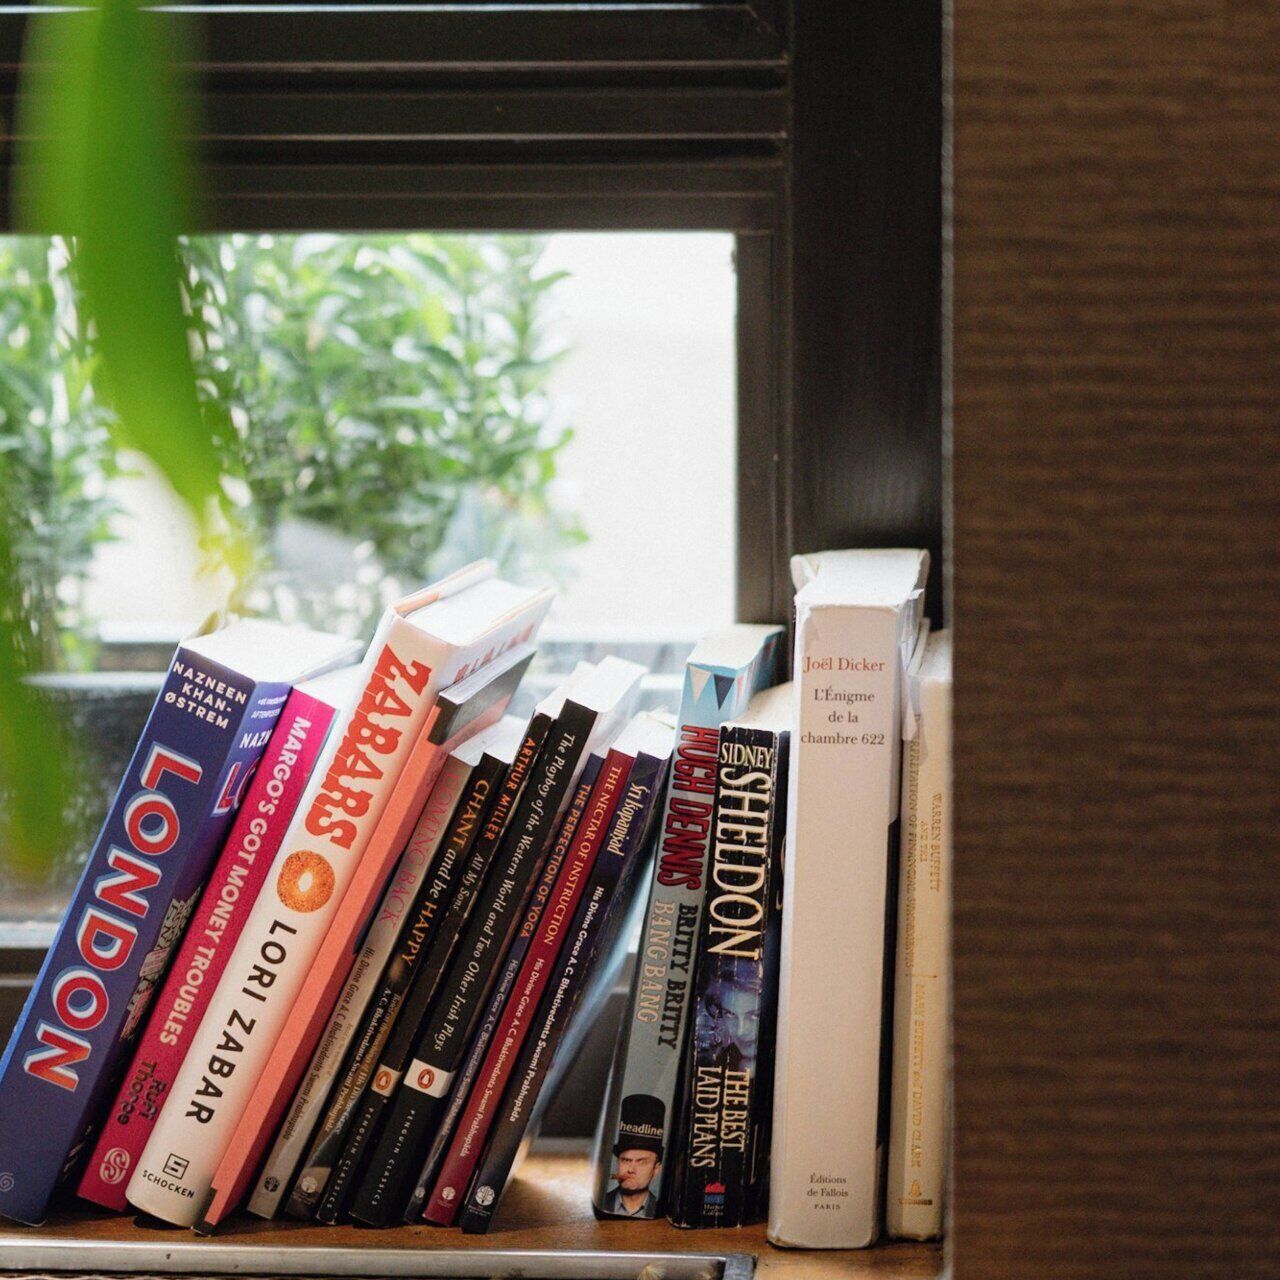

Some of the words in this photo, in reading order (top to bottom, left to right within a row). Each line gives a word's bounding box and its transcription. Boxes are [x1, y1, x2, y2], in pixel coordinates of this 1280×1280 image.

[803, 656, 832, 674] Joël
[838, 657, 885, 672] Dicker
[173, 661, 247, 705] NAZNEEN
[182, 682, 232, 712] KHAN-
[814, 685, 875, 706] L'Énigme
[164, 691, 230, 730] ØSTREM
[828, 710, 844, 722] de
[848, 712, 858, 723] la
[304, 643, 432, 850] ZABARS
[558, 733, 575, 753] The
[800, 731, 858, 744] chambre
[861, 733, 885, 746] 622
[258, 716, 312, 816] MARGO'S
[507, 738, 535, 789] ARTHUR
[672, 724, 720, 795] HUGH
[720, 742, 774, 770] SIDNEY
[538, 755, 565, 797] Playboy
[604, 767, 622, 791] THE
[531, 799, 544, 816] of
[575, 785, 591, 807] THE
[453, 780, 489, 847] CHANT
[485, 794, 510, 839] MILLER
[526, 813, 539, 831] the
[584, 792, 610, 839] NECTAR
[908, 814, 917, 828] OF
[931, 793, 941, 841] WARREN
[238, 817, 268, 865] GOT
[507, 835, 533, 874] Western
[544, 809, 579, 883] PERFECTION
[578, 842, 591, 859] OF
[657, 798, 714, 890] DENNIS
[438, 849, 456, 878] and
[471, 853, 483, 870] All
[707, 767, 771, 961] SHELDON
[906, 832, 916, 894] FINANCIAL
[930, 844, 940, 892] BUFFETT
[429, 879, 446, 898] be
[463, 870, 476, 886] My
[537, 885, 548, 902] OF
[592, 886, 604, 900] His
[202, 864, 249, 944] MONEY
[379, 867, 418, 927] BACK
[453, 887, 469, 910] Sons
[493, 879, 514, 912] World
[544, 861, 583, 944] INSTRUCTION
[23, 740, 203, 1092] LONDON
[483, 912, 496, 935] and
[520, 906, 541, 937] YOGA
[582, 901, 598, 929] Divine
[646, 899, 676, 961] BANG
[399, 902, 437, 965] HAPPY
[473, 937, 490, 957] Two
[572, 930, 587, 956] Grace
[670, 903, 698, 974] BRITTY
[242, 920, 298, 1003] LORI
[362, 946, 375, 959] His
[508, 959, 518, 971] His
[533, 958, 544, 971] His
[352, 959, 369, 983] Divine
[460, 961, 479, 993] Other
[499, 971, 513, 992] Divine
[524, 971, 539, 995] Divine
[160, 944, 216, 1047] TROUBLES
[342, 983, 358, 1004] Grace
[447, 995, 465, 1020] Irish
[491, 993, 504, 1012] Grace
[515, 996, 529, 1017] Grace
[637, 963, 666, 1022] BANG
[541, 978, 569, 1039] Bhaktivedanta
[658, 978, 687, 1050] BRITTY
[434, 1023, 453, 1051] Plays
[184, 1008, 256, 1125] ZABAR
[487, 1037, 513, 1088] Bhaktivedanta
[529, 1040, 546, 1070] Swami
[344, 1061, 359, 1086] Swami
[696, 1066, 722, 1108] LAID
[722, 1067, 750, 1107] THE
[478, 1088, 492, 1113] Swami
[350, 1108, 373, 1154] PENGUIN
[394, 1110, 415, 1153] PENGUIN
[620, 1122, 664, 1136] headline
[690, 1111, 719, 1168] PLANS
[720, 1108, 748, 1152] BEST
[911, 1130, 921, 1167] CLARK
[142, 1170, 196, 1200] SCHOCKEN
[327, 1160, 350, 1208] CLASSICS
[372, 1159, 394, 1205] CLASSICS
[806, 1188, 818, 1197] de
[820, 1188, 848, 1198] Fallois
[810, 1172, 847, 1184] Éditions
